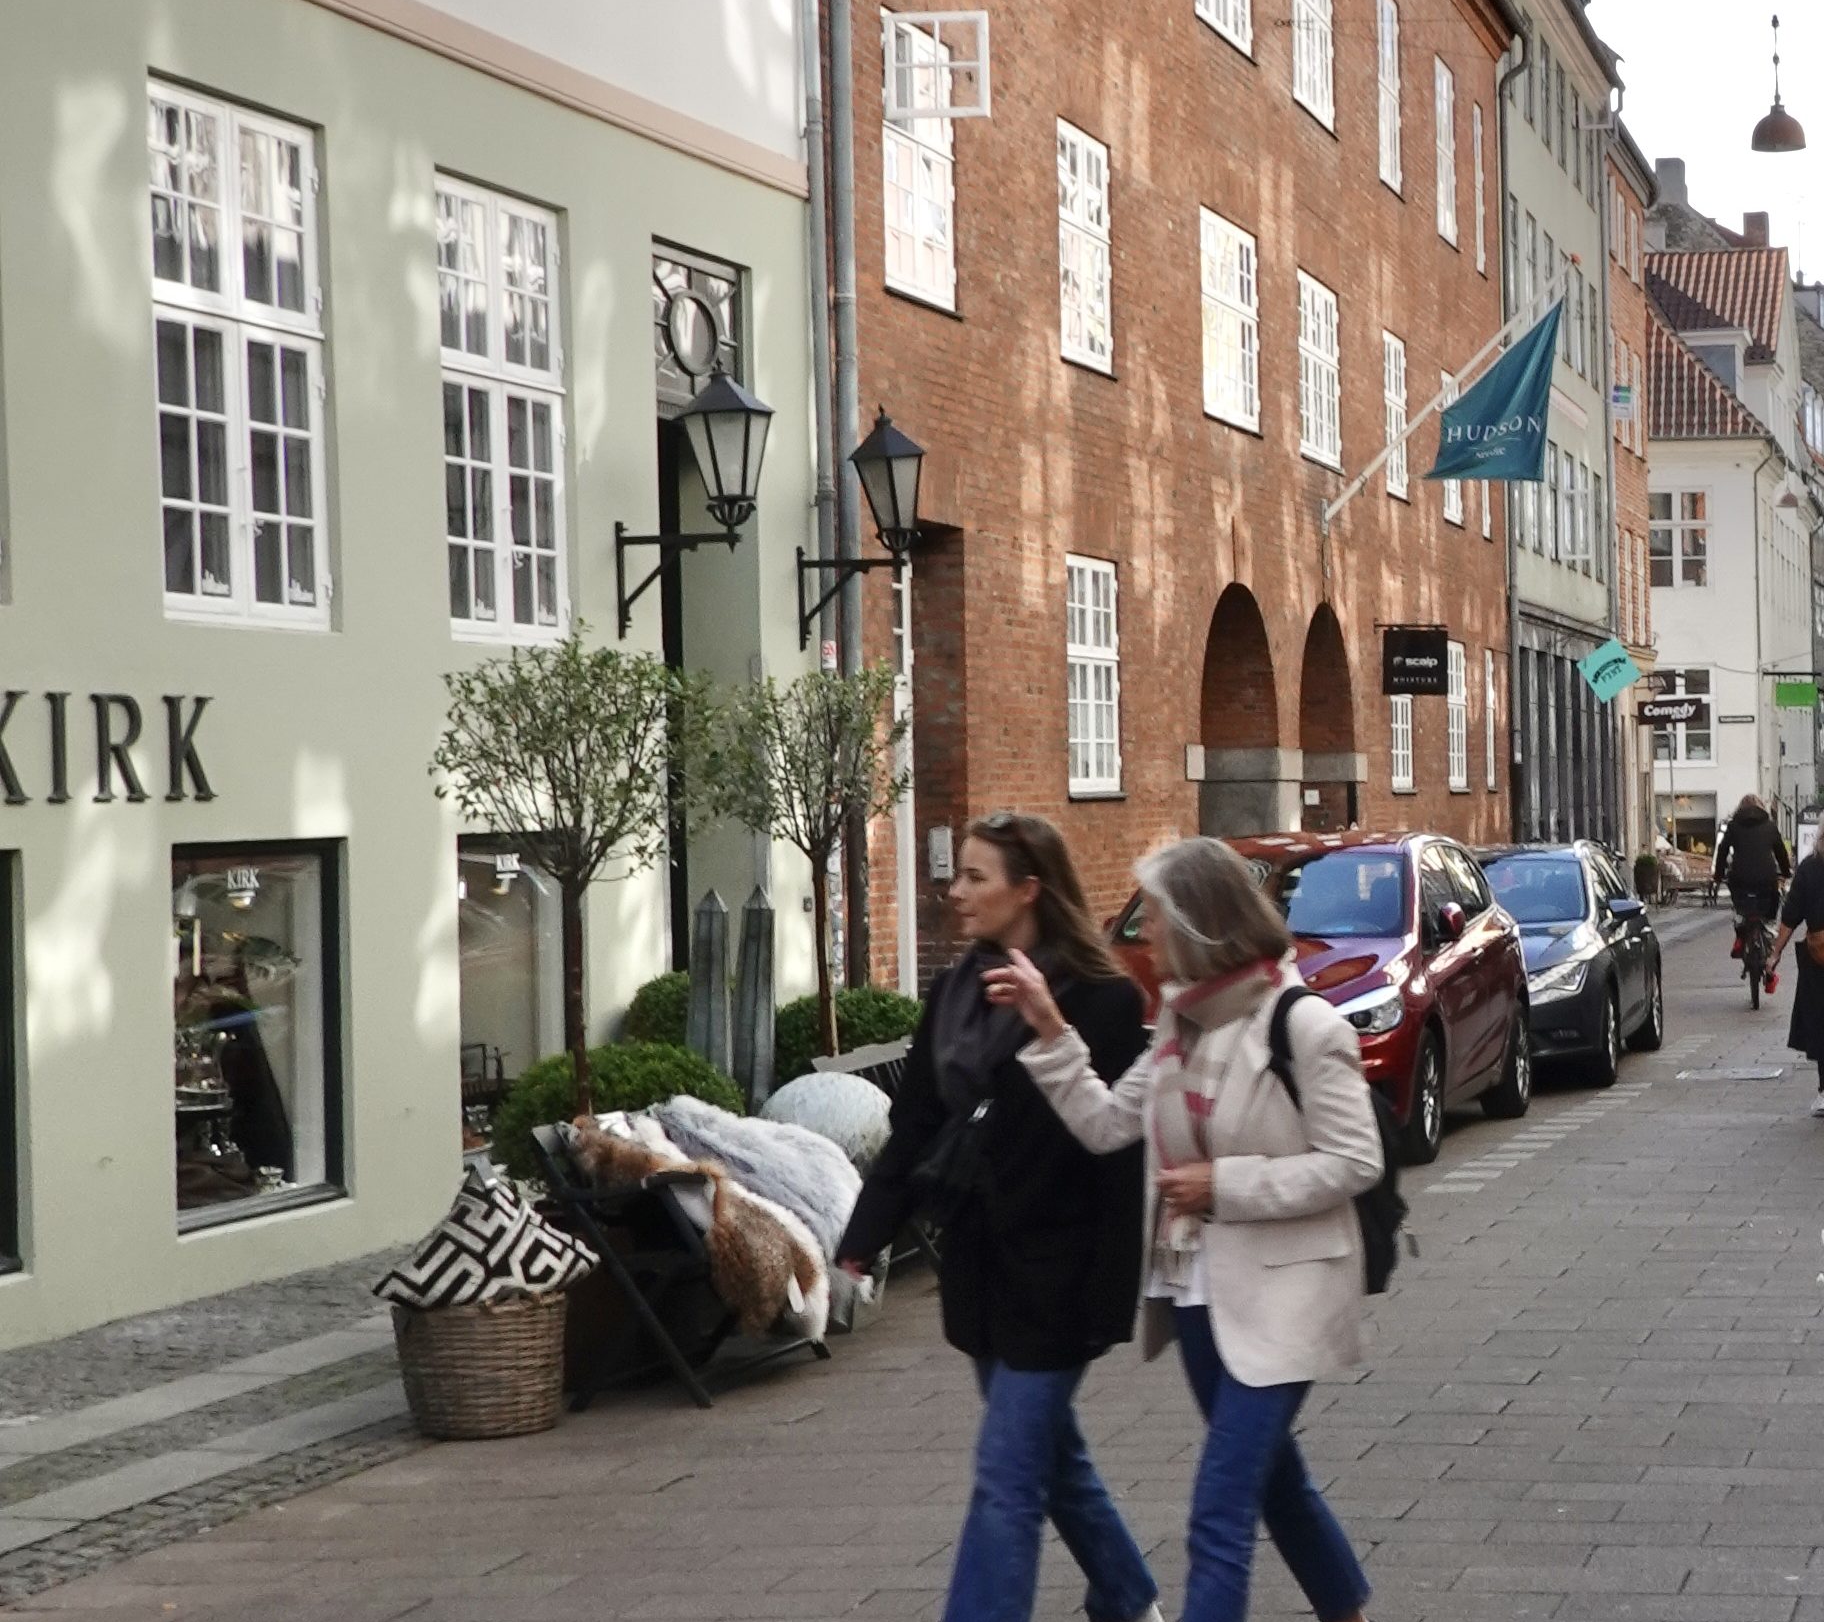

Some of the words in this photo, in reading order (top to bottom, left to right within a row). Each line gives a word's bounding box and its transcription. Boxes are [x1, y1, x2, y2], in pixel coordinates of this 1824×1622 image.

[1446, 415, 1542, 444] HUDSON
[1643, 702, 1697, 717] Comedy
[227, 867, 260, 889] KIRK
